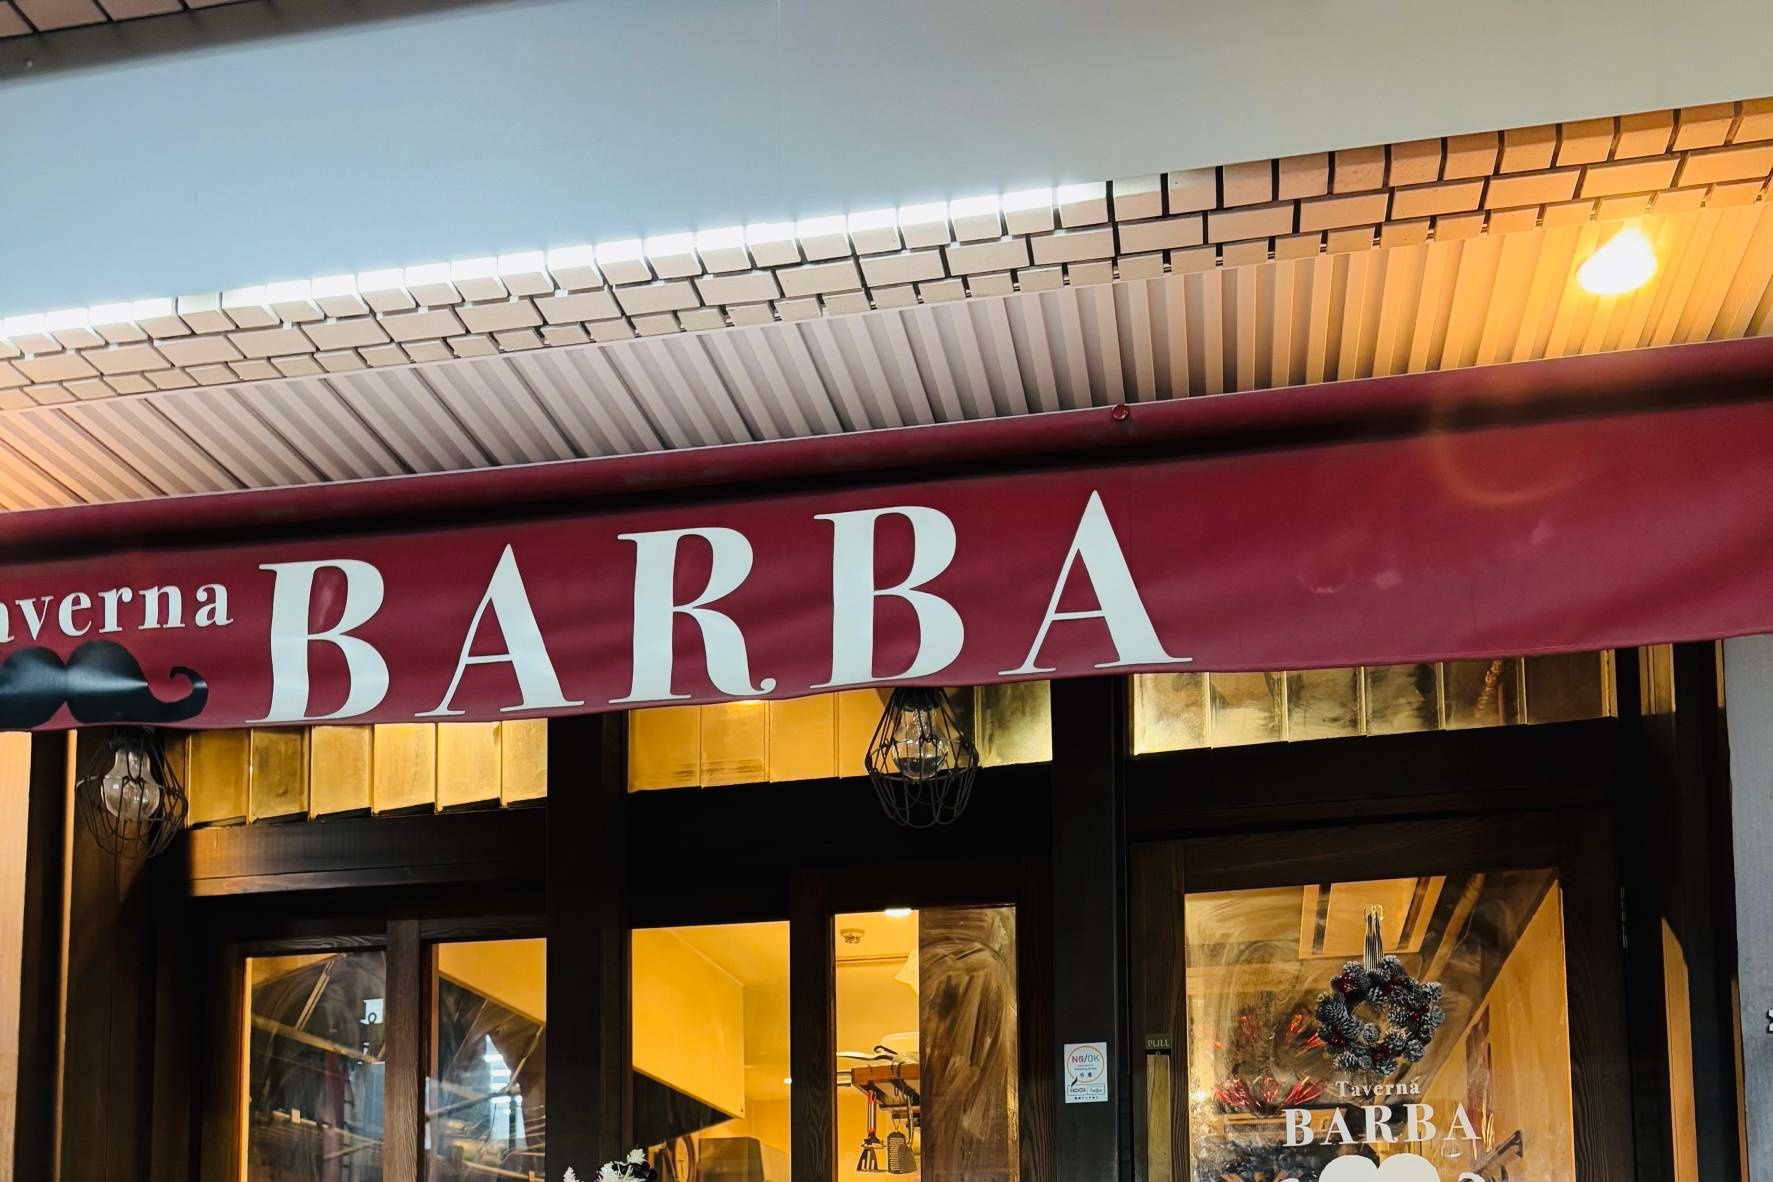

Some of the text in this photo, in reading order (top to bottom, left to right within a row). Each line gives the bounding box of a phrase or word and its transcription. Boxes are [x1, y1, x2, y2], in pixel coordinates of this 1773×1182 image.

[245, 490, 1194, 724] BARBA
[1335, 1080, 1421, 1097] Taverna
[1282, 1103, 1481, 1147] BARBA
